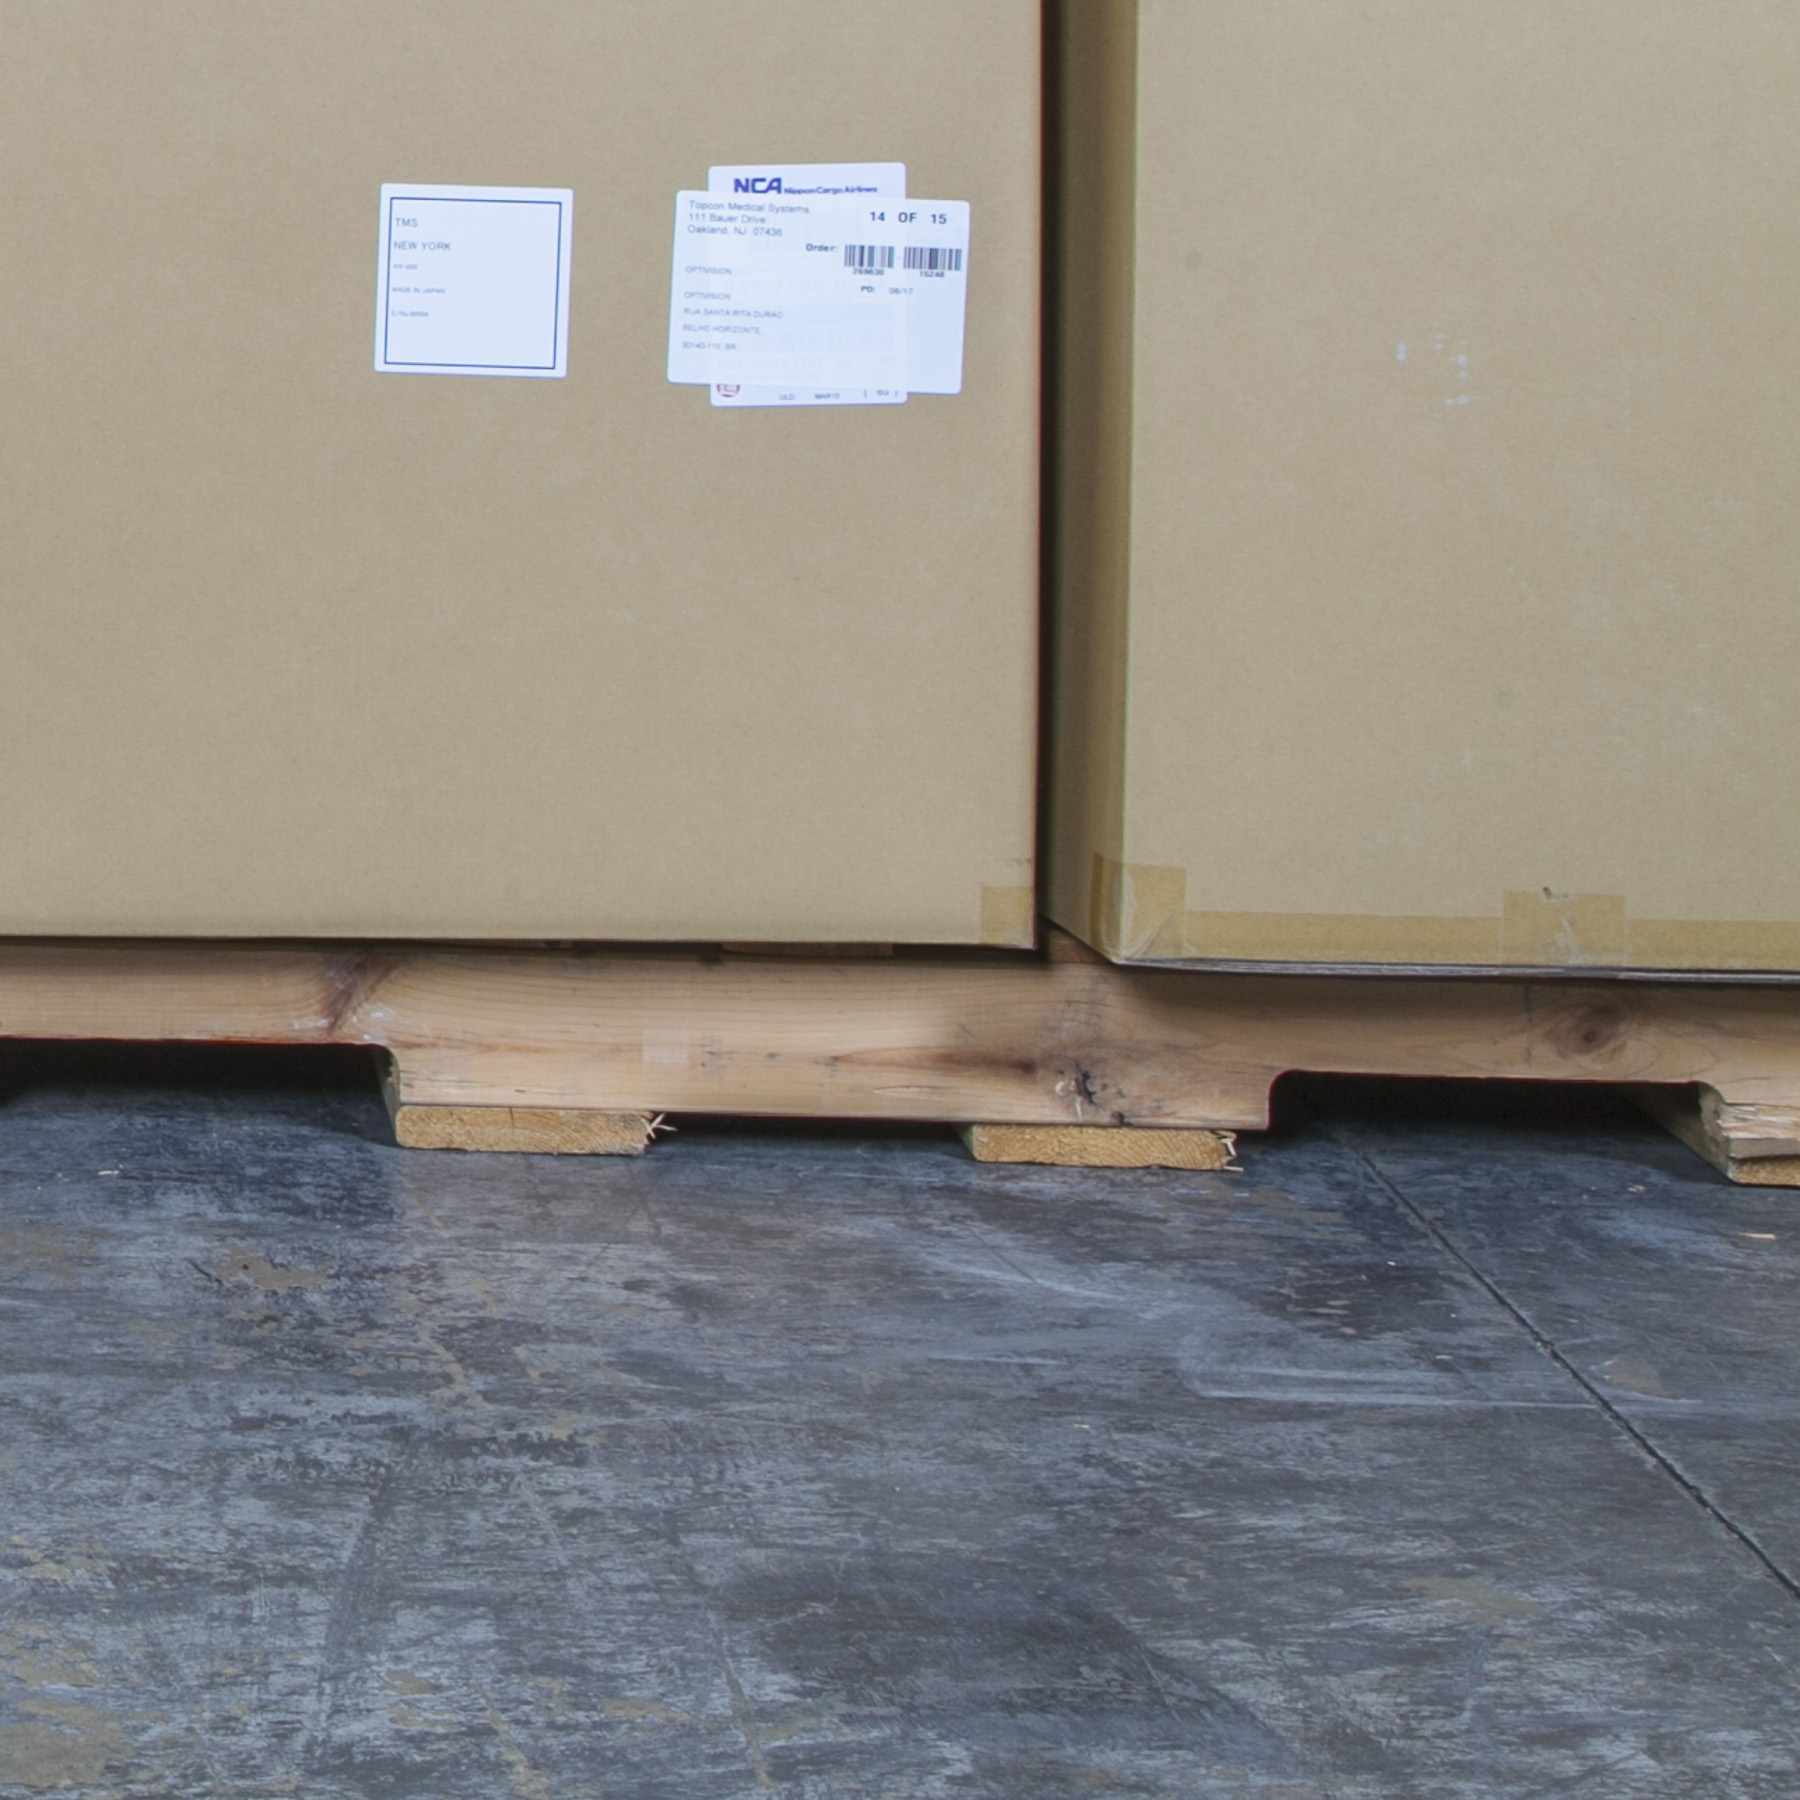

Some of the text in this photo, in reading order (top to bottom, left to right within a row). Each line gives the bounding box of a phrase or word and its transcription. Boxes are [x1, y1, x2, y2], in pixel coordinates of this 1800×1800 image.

[734, 177, 782, 194] NCA
[689, 201, 948, 224] Topcon Medical Systems 14 OF 15
[395, 218, 418, 227] TMS
[689, 213, 766, 224] 111 Bauer Drive
[734, 226, 746, 236] NJ
[753, 227, 782, 236] 07436
[394, 242, 451, 251] NEW YORK
